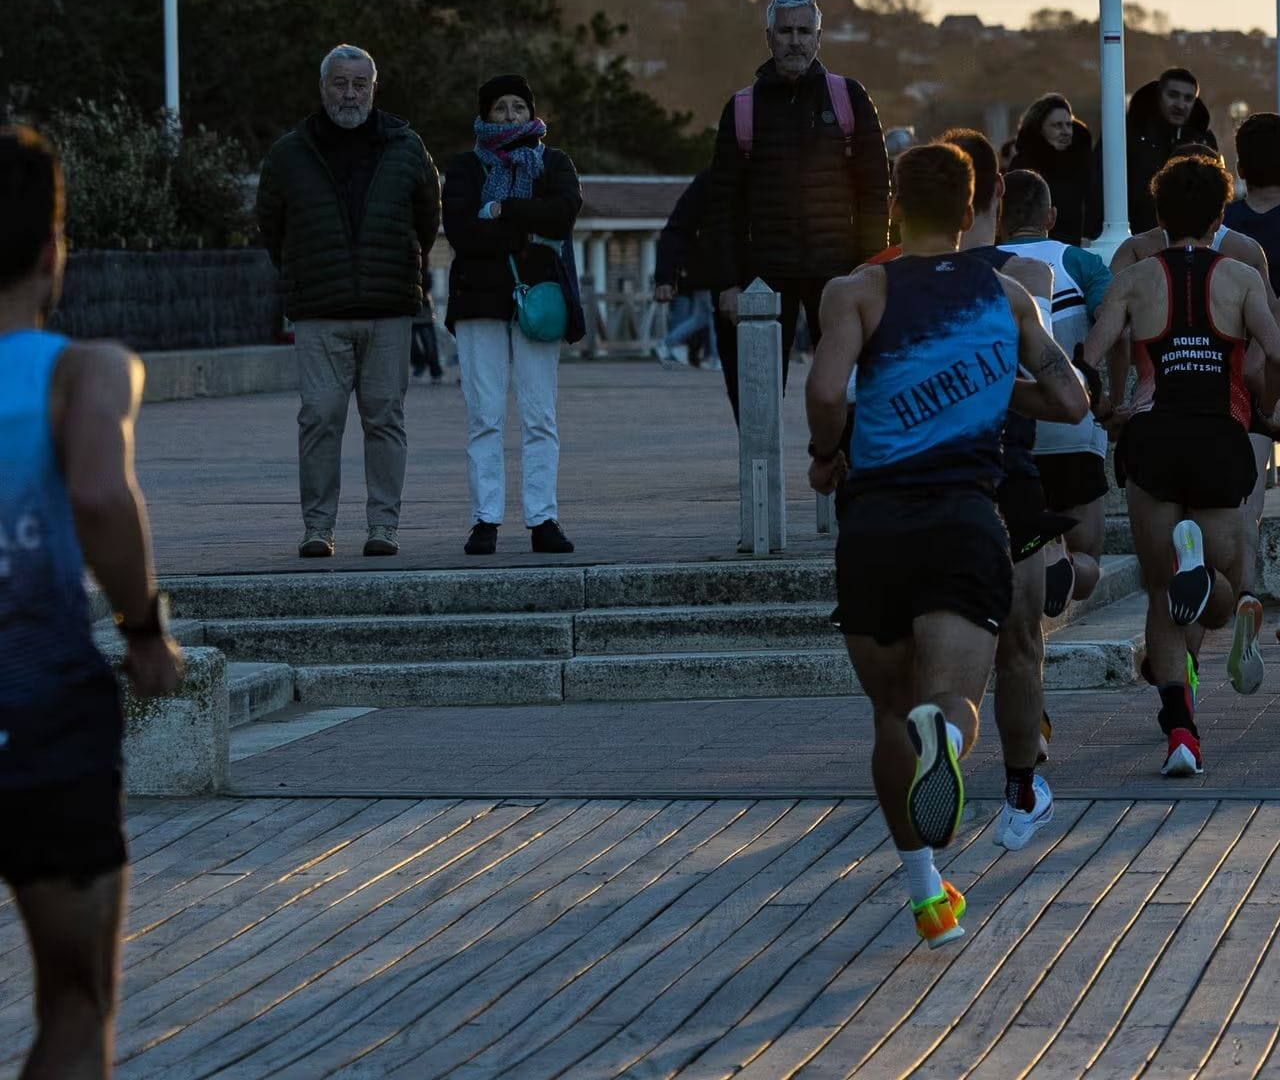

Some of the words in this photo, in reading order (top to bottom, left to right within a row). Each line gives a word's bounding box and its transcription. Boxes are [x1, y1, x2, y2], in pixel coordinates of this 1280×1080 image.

[1173, 336, 1211, 347] ROUEN
[1161, 349, 1223, 363] NORMANDIE
[888, 360, 979, 430] HAVRE
